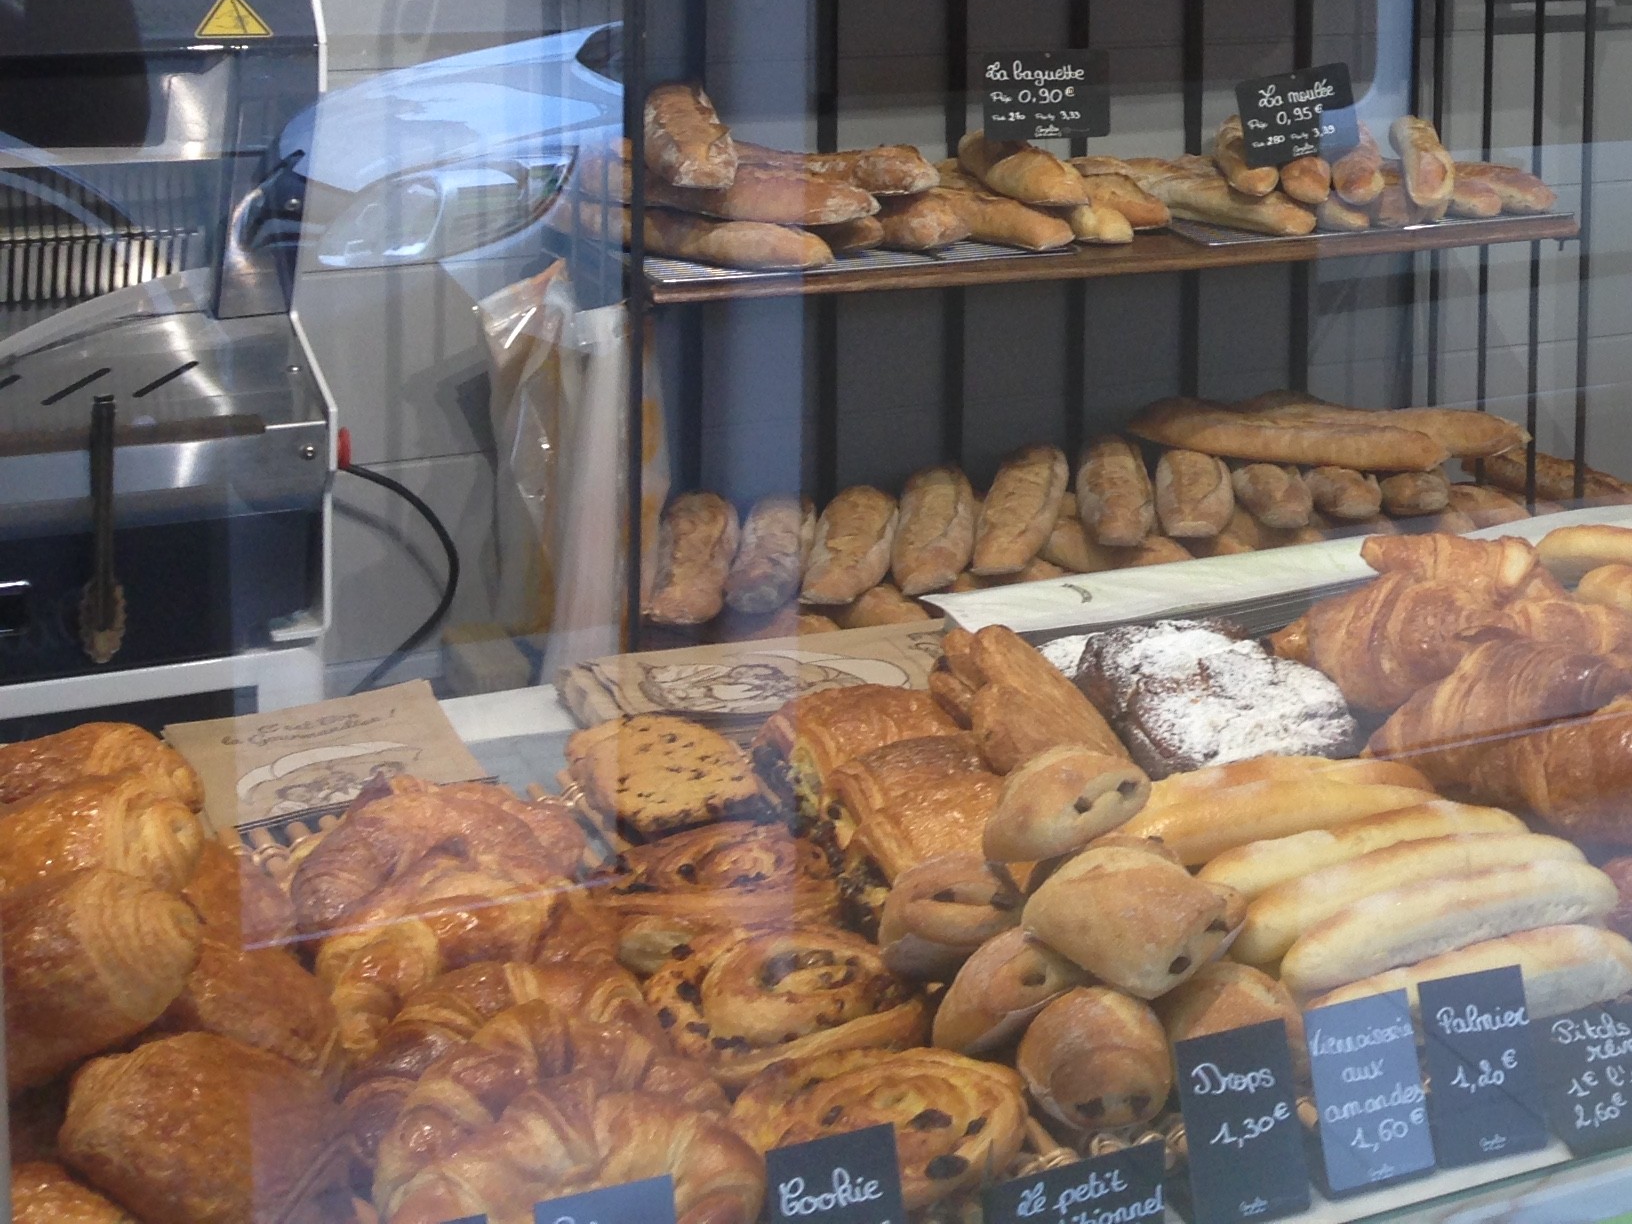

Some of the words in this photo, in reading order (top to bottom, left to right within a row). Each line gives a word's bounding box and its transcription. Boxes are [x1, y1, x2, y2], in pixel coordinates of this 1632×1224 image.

[985, 61, 1009, 80] La
[1013, 60, 1085, 86] baguette
[1258, 84, 1284, 108] La
[1287, 79, 1335, 103] moulée
[1436, 1004, 1530, 1034] Palmier
[1191, 1062, 1276, 1094] Drops
[1341, 1058, 1384, 1083] aux
[1324, 1082, 1426, 1123] amandes
[1209, 1101, 1291, 1149] 1,30€
[778, 1166, 884, 1216] Cookie
[1016, 1181, 1047, 1217] Le
[1052, 1169, 1128, 1215] petit
